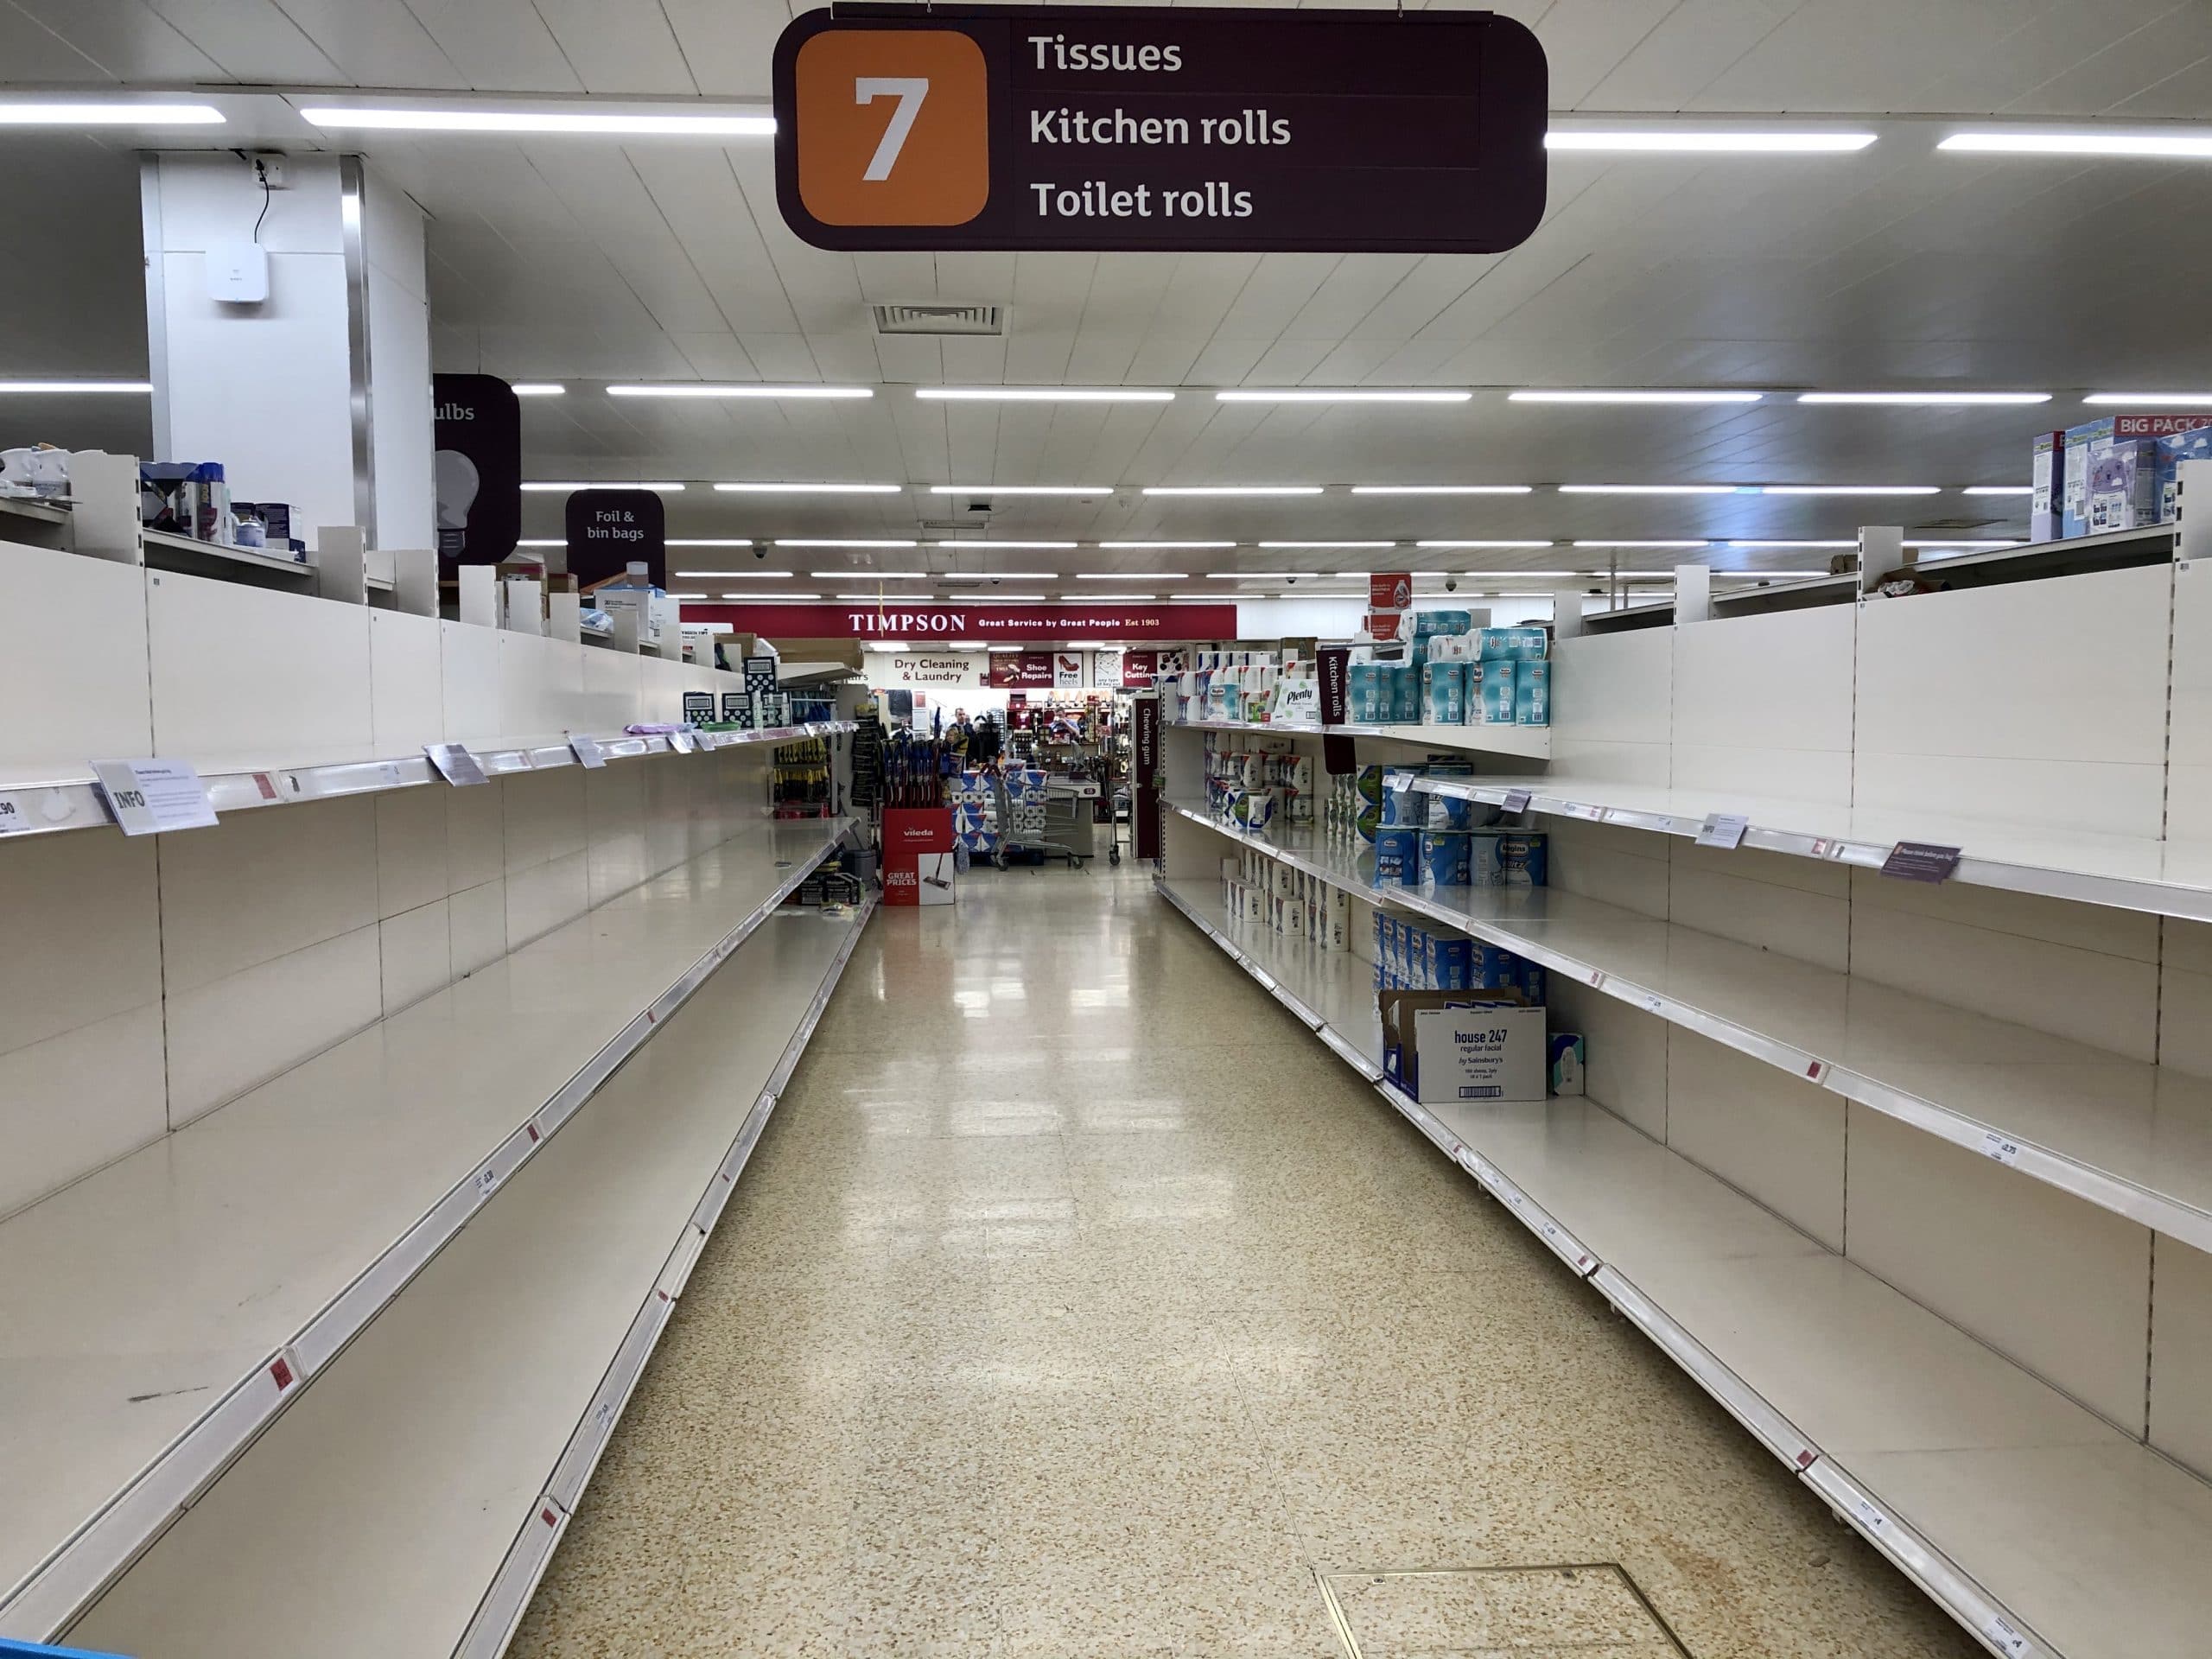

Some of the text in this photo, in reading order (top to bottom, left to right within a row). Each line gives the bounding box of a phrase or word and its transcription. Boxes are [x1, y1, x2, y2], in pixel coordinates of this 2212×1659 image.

[1028, 35, 1182, 71] Tissues
[855, 78, 929, 181] 7
[1031, 108, 1292, 146] Kitchen rolls
[1031, 181, 1254, 218] Toilet rolls
[2120, 418, 2150, 432] BIG
[2153, 418, 2197, 432] PACK
[595, 511, 634, 523] Foil &
[587, 526, 645, 542] bin bags
[849, 614, 965, 632] TIMPSON
[978, 619, 1121, 628] Great Service by Great People
[894, 658, 970, 671] Dry Cleaning
[1132, 664, 1148, 673] Key
[902, 671, 962, 683] & Laundry
[1329, 656, 1341, 717] Kitchen rolls
[1287, 689, 1313, 705] Plenty
[1141, 709, 1151, 765] Chewing gum
[113, 791, 145, 809] INFO
[1454, 1029, 1508, 1043] house 247
[1460, 1045, 1484, 1053] regular
[1459, 1057, 1466, 1065] by
